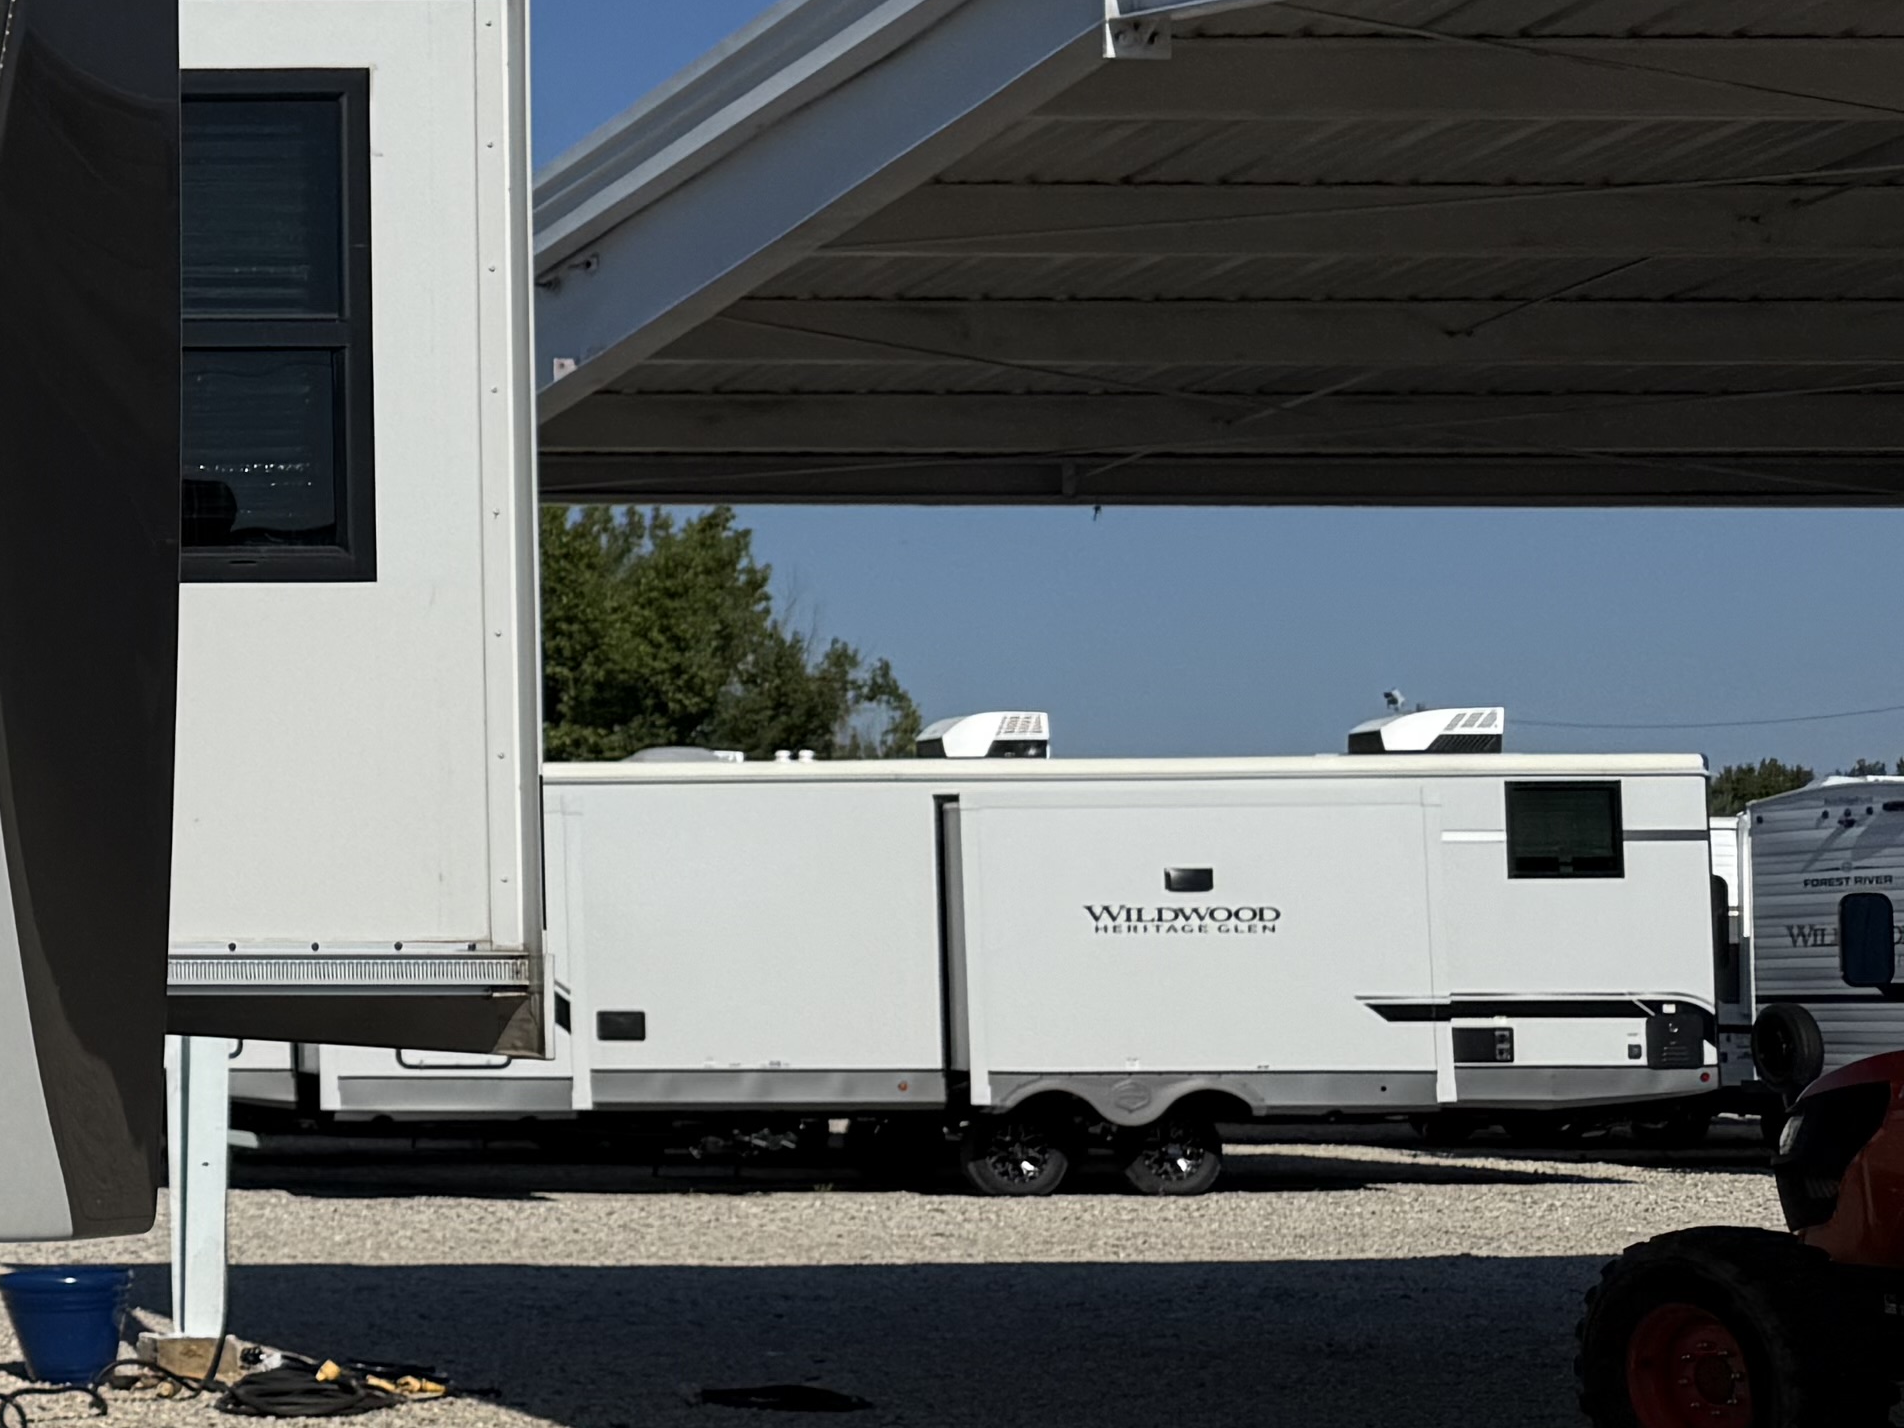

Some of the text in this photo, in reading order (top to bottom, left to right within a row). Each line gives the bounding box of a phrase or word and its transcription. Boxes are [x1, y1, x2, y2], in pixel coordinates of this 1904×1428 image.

[1803, 874, 1893, 888] FOREST RIVER
[1082, 904, 1282, 923] WILDWOOD
[1094, 923, 1277, 934] HERITAGE GLEN
